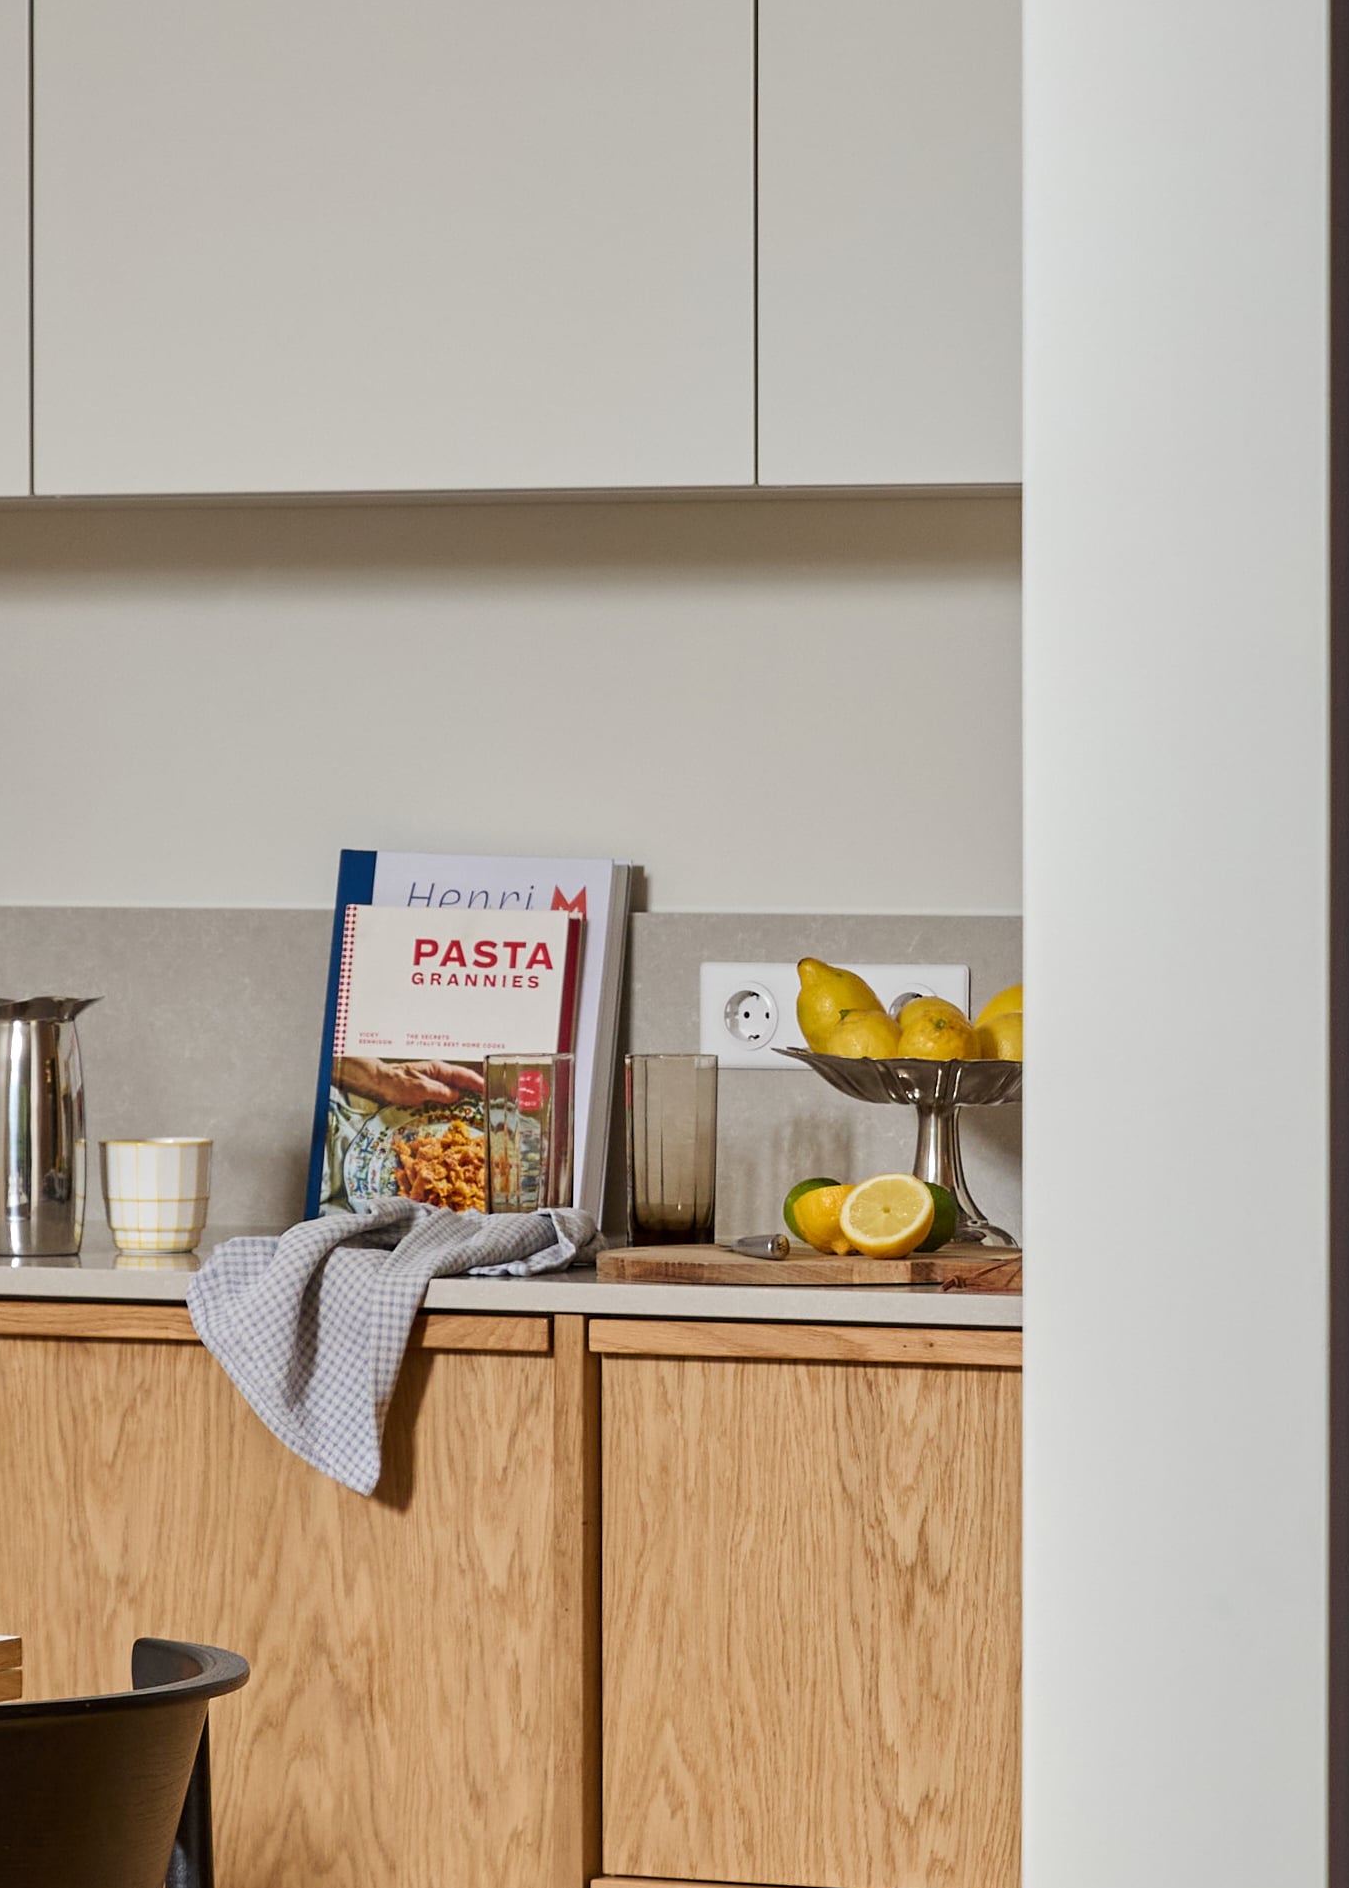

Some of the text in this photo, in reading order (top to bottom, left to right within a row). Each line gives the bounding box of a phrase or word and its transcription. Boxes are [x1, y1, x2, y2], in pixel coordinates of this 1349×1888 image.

[407, 881, 535, 910] Henri
[413, 938, 553, 970] PASTA
[411, 971, 540, 989] GRANNIES
